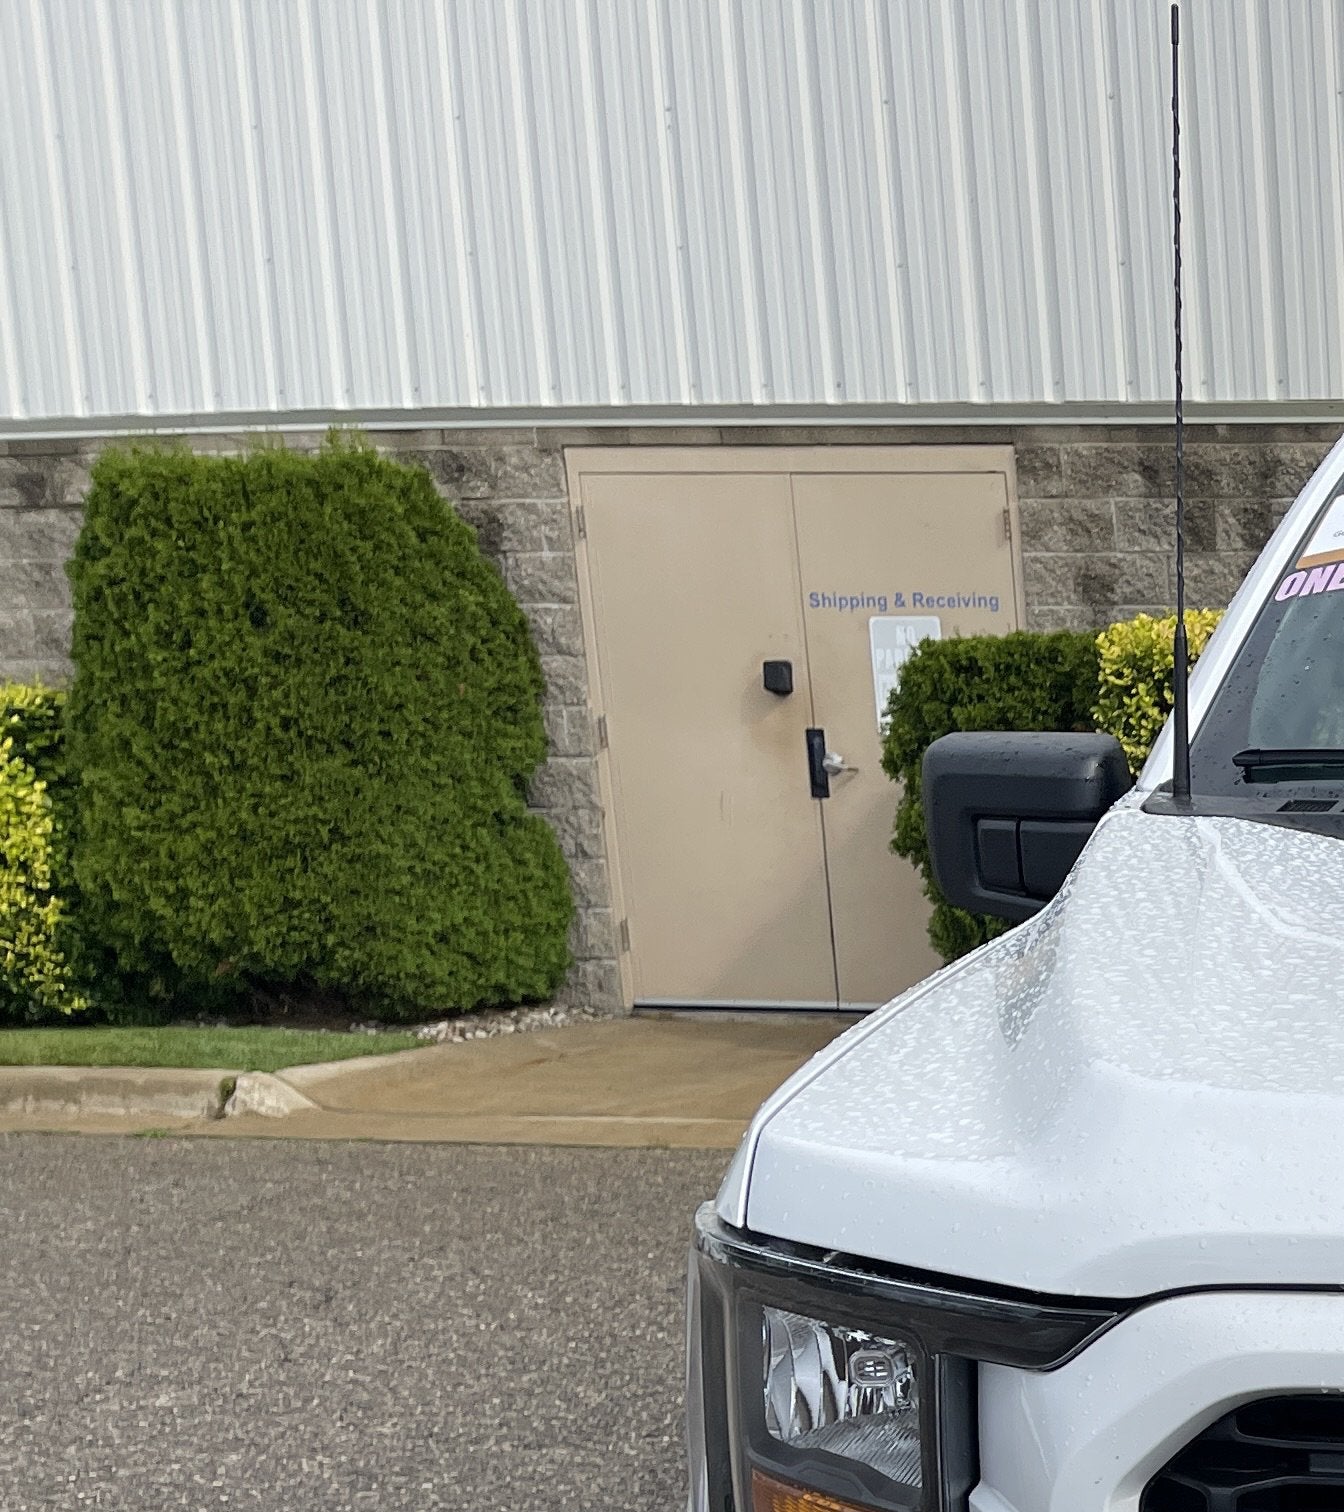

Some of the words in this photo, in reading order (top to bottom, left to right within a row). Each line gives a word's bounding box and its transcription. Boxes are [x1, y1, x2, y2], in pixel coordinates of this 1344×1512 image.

[808, 591, 888, 612] Shipping
[894, 592, 906, 608] &
[912, 592, 1000, 612] Receiving
